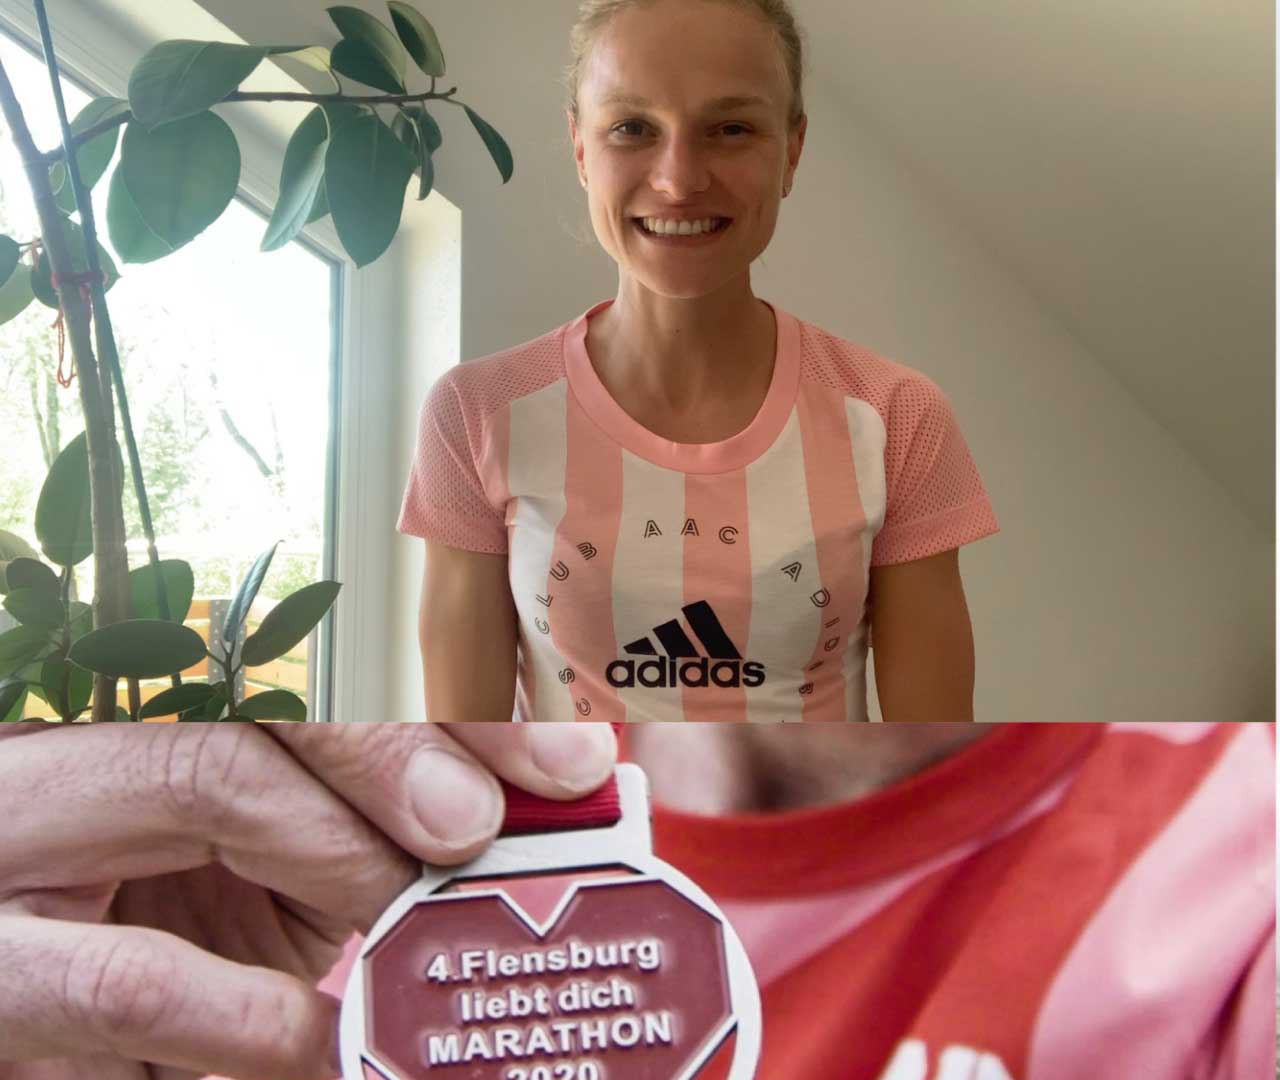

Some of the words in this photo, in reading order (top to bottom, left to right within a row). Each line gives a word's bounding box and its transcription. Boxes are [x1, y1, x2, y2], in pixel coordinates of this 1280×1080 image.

[644, 518, 739, 545] AAC
[605, 657, 766, 688] adidas
[461, 984, 548, 1020] liebt
[558, 979, 634, 1012] dich
[428, 1013, 671, 1065] MARATHON
